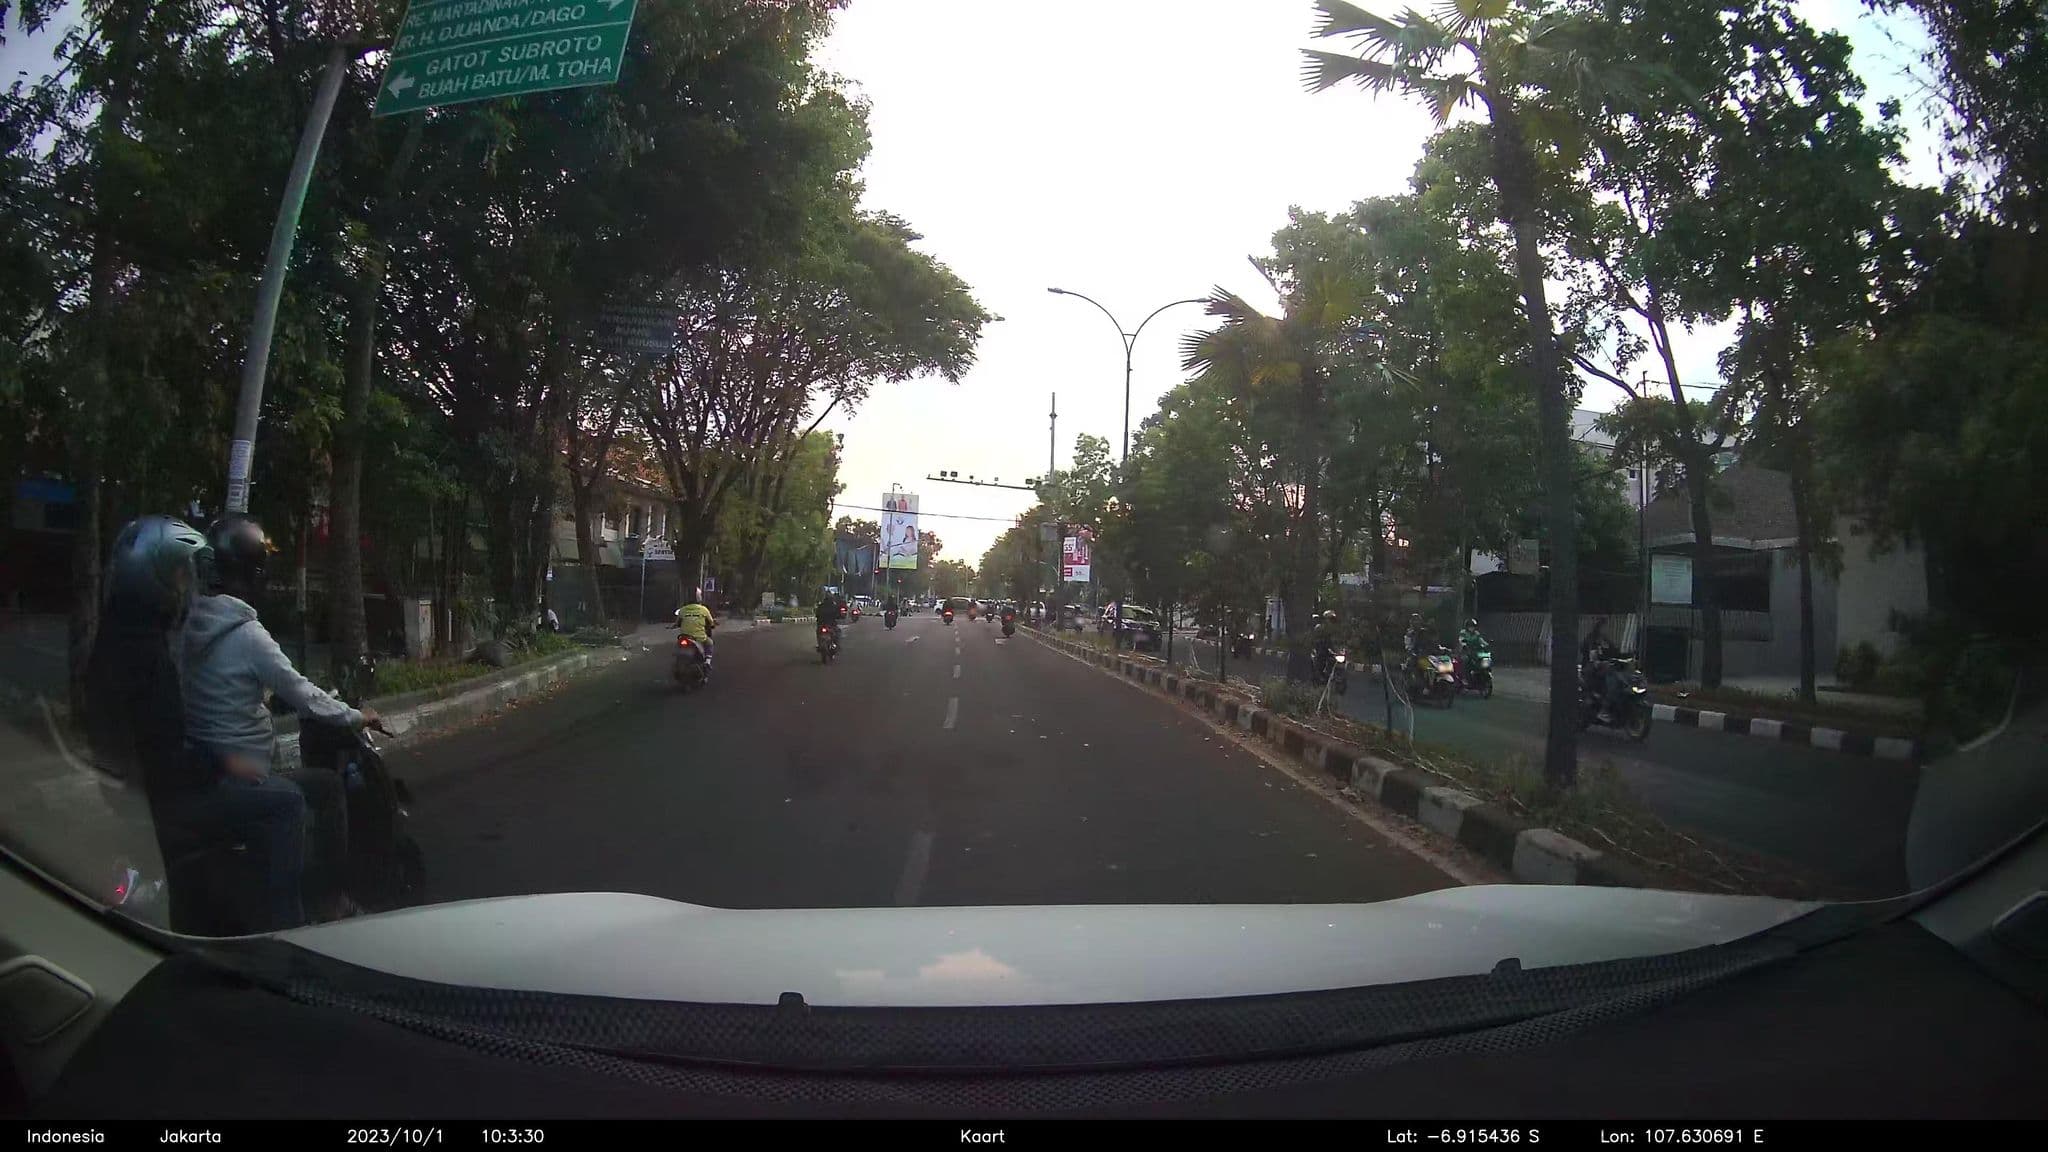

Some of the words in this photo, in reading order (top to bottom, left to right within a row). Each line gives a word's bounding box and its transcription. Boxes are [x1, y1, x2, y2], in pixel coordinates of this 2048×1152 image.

[438, 4, 586, 42] DJUANDA/DAGO
[426, 50, 492, 76] GATOT
[498, 35, 602, 63] SUBROTO
[418, 75, 469, 99] BUAH
[471, 64, 551, 91] BATU/M.
[558, 57, 612, 78] TOHA
